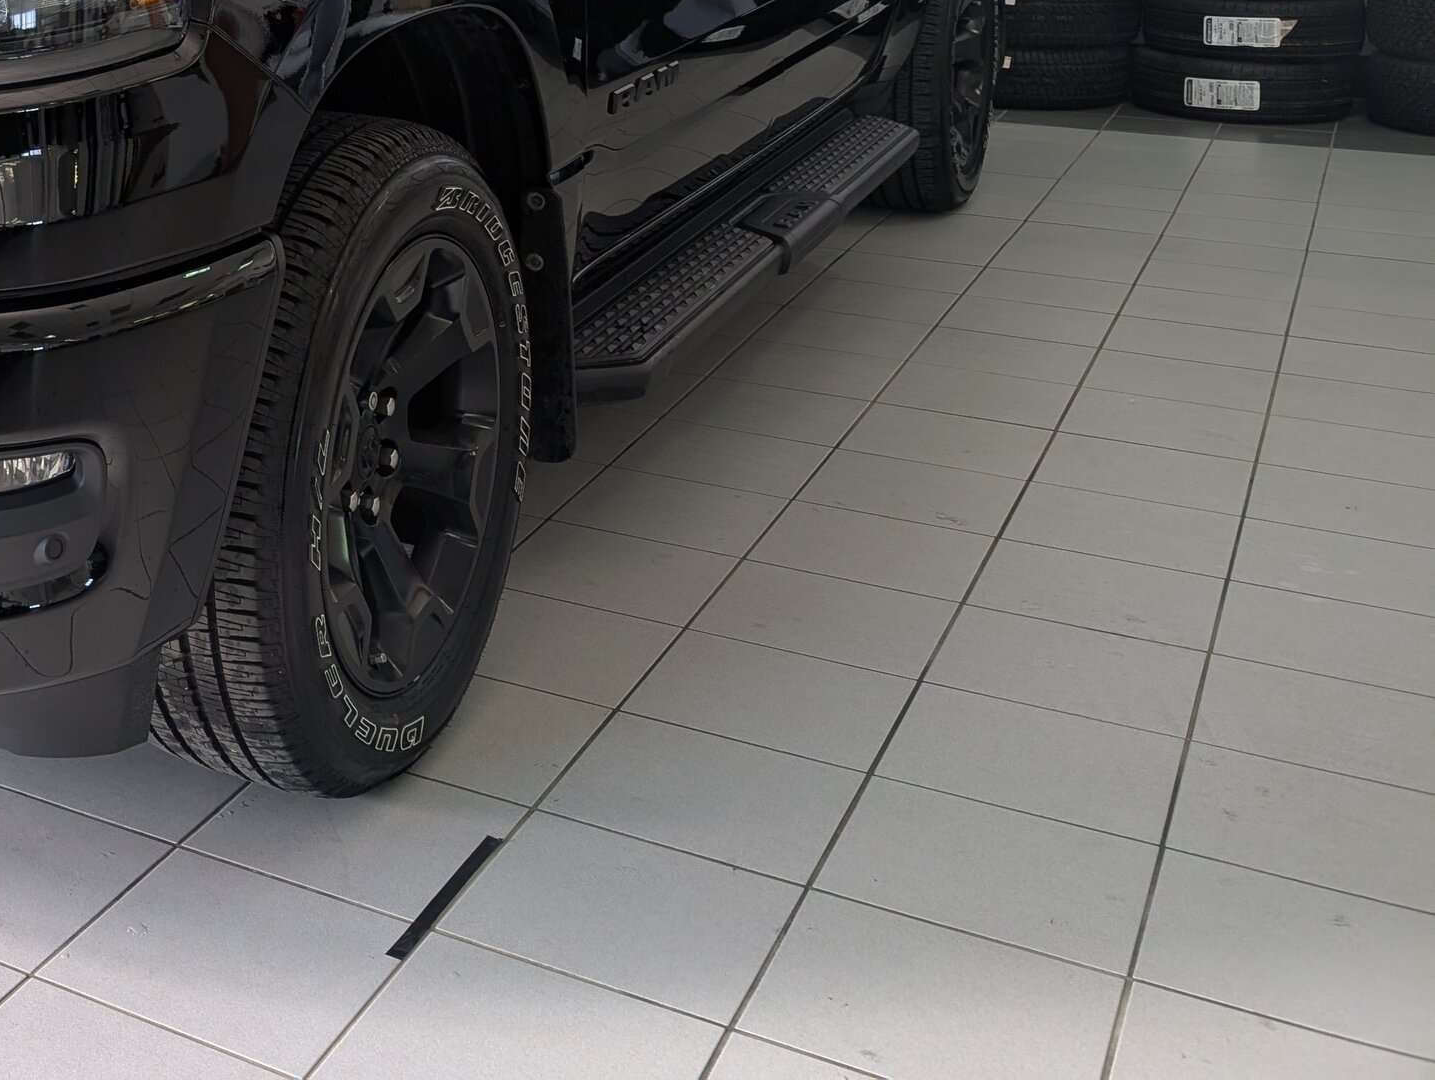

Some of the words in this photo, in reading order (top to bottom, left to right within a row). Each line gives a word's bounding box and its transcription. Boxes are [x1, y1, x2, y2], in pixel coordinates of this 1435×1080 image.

[607, 60, 678, 114] RAM
[434, 184, 531, 503] BRIDGESTONE
[311, 613, 424, 752] DUELER
